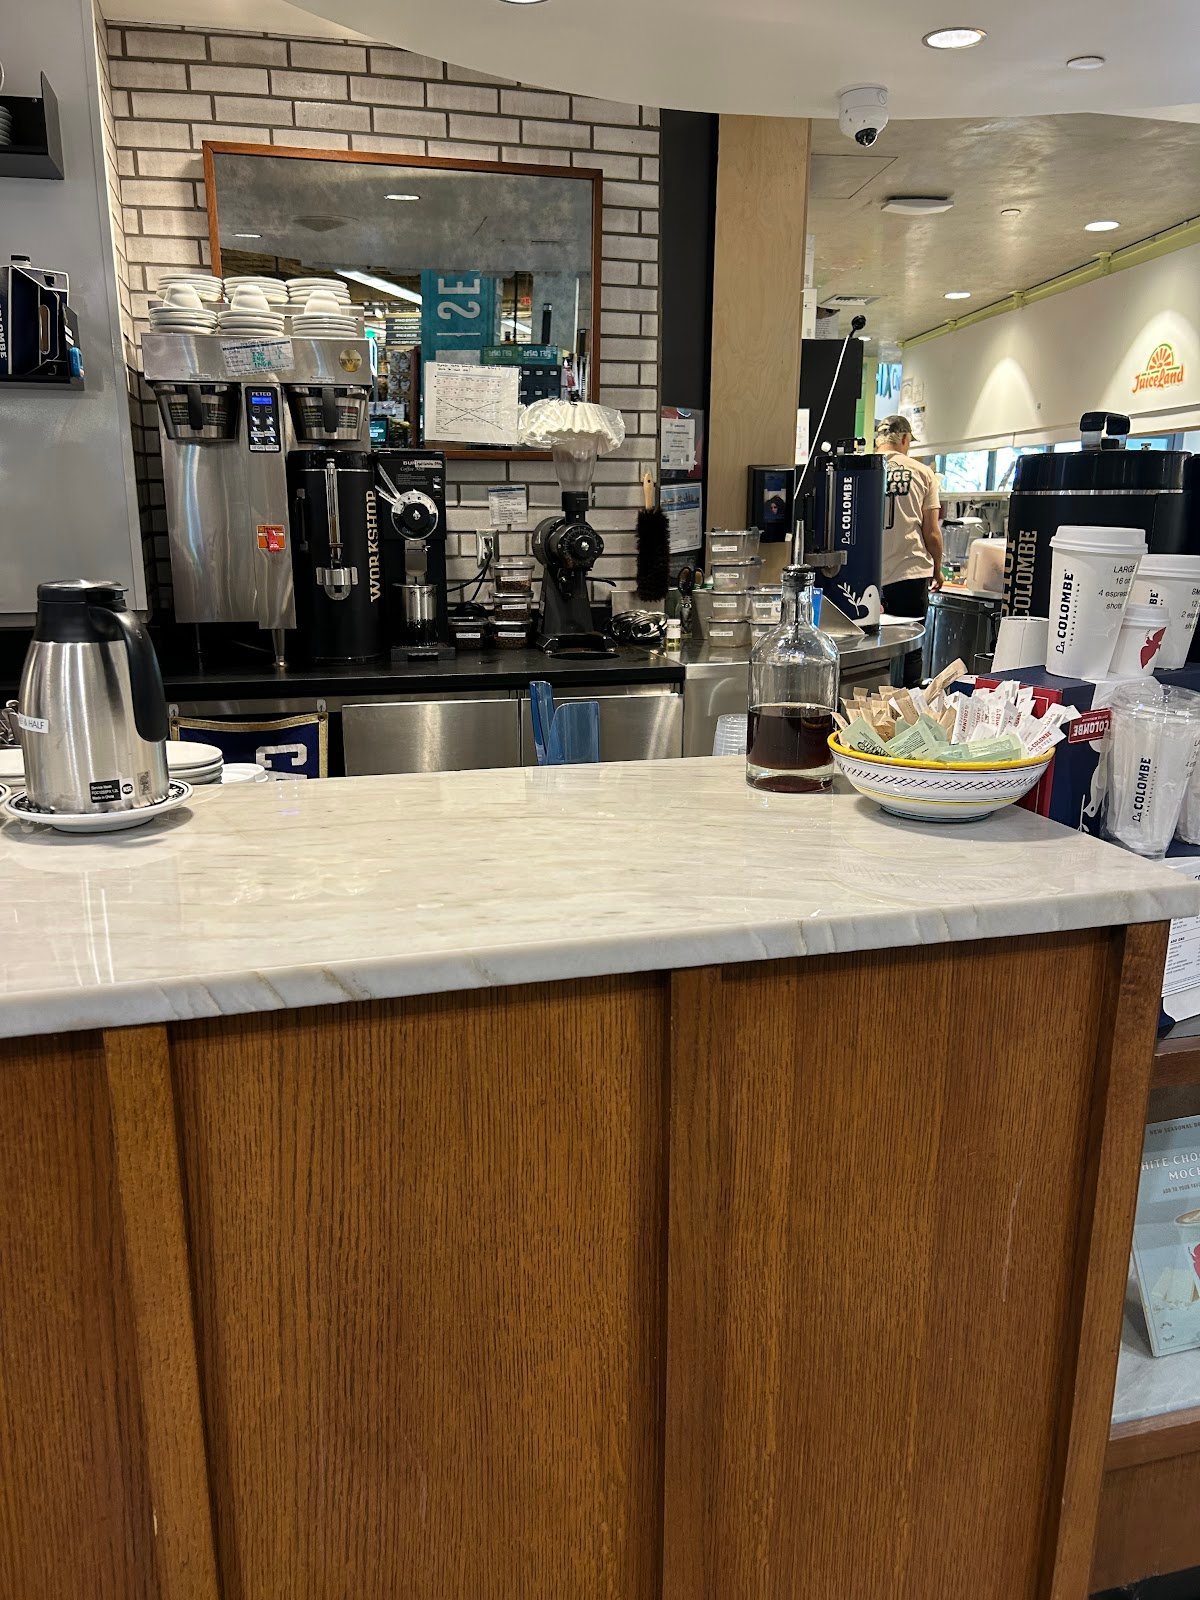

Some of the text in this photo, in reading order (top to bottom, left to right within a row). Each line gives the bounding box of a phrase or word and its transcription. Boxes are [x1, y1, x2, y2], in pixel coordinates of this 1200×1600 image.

[1132, 364, 1184, 393] JuiceLand
[841, 476, 853, 545] La COLOMBE
[366, 490, 381, 603] WORKSHOP
[1012, 530, 1038, 617] COLOMBE
[1098, 589, 1104, 597] 4
[1056, 572, 1074, 655] La COLOMBE
[28, 719, 45, 729] HALF
[1072, 720, 1110, 737] COLOMBE
[1031, 731, 1053, 748] COLOMBE
[256, 743, 308, 775] C
[1132, 757, 1152, 823] La COLOMBE
[1164, 1124, 1192, 1133] SEASONAL
[1173, 1152, 1200, 1165] CHO
